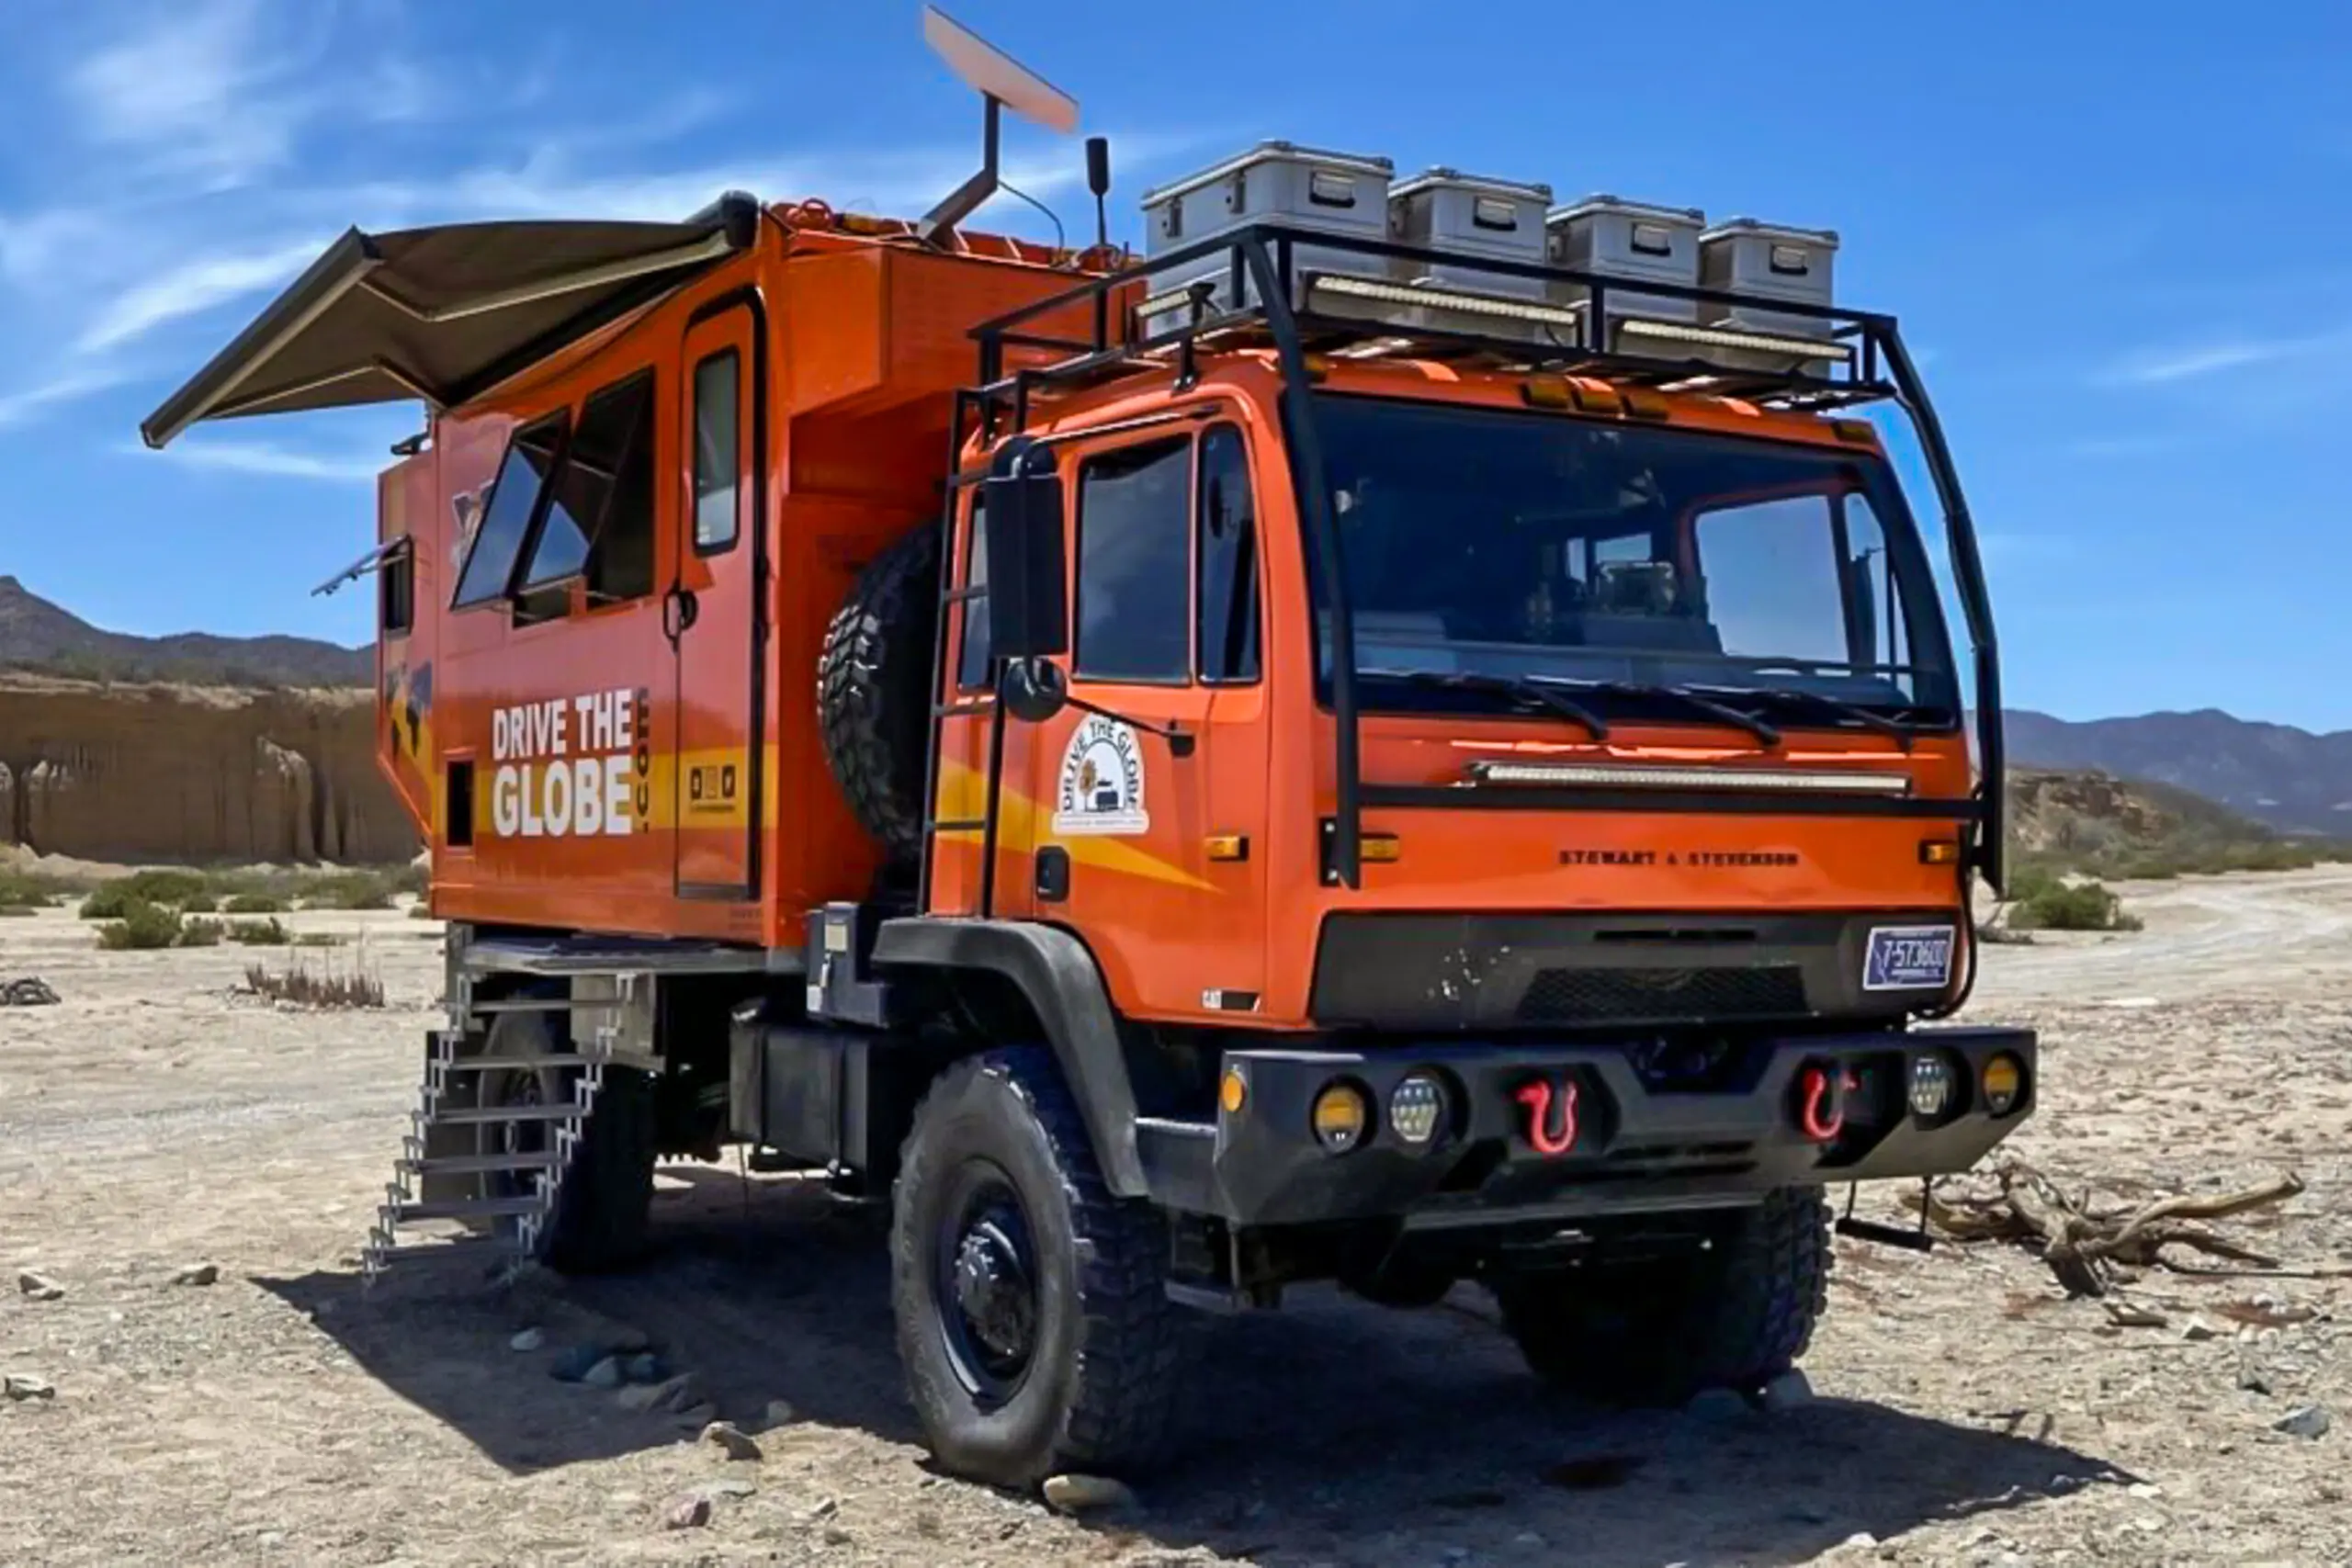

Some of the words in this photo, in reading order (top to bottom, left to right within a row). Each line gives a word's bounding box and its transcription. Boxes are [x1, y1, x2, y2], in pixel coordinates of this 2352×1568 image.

[492, 698, 567, 761] DRIVE
[575, 689, 633, 751] THE
[1090, 719, 1114, 739] THE
[492, 754, 633, 837] GLOBE
[1559, 850, 1656, 865] STEWART
[1688, 852, 1799, 866] STEVENSON
